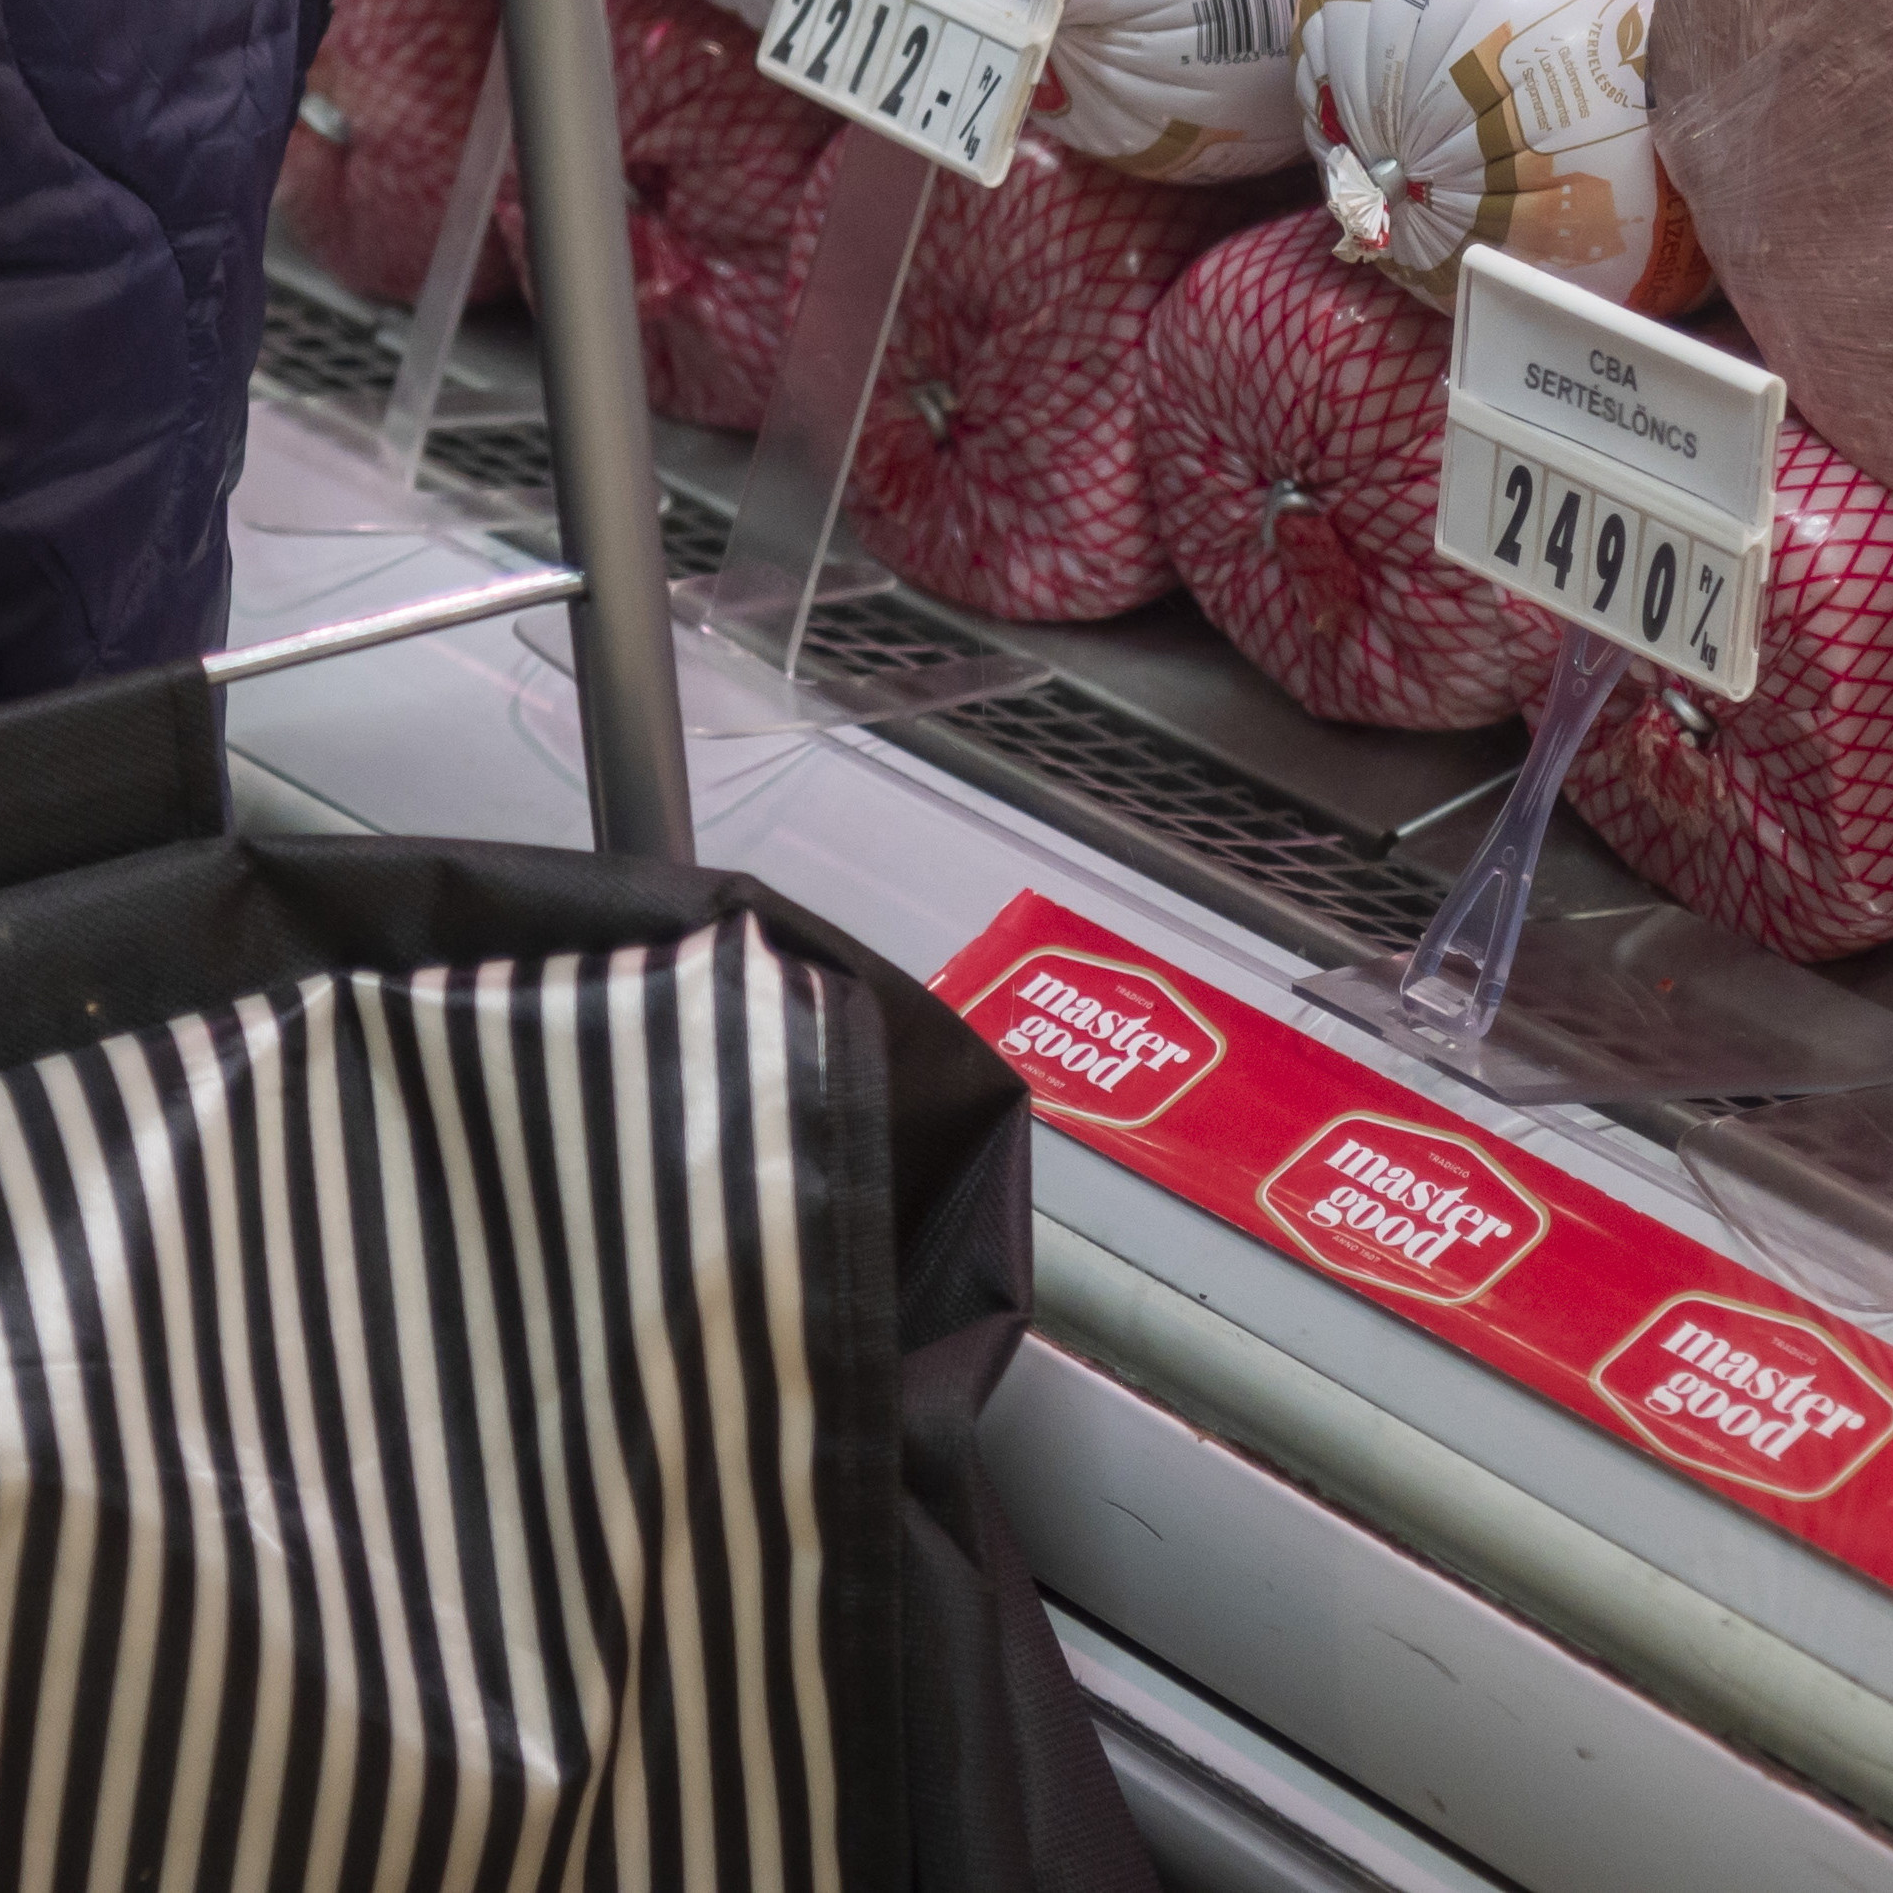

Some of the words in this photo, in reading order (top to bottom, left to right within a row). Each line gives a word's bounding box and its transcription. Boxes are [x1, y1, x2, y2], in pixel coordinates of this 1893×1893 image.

[1586, 20, 1631, 109] TERMELÉSBŐL
[1523, 361, 1700, 461] SERTÉSLÖNCS
[1588, 347, 1640, 394] CBA
[1493, 462, 1679, 645] 2490
[1014, 970, 1191, 1073] master
[1114, 983, 1155, 1011] TRADICIÓ
[997, 1012, 1145, 1094] good
[1020, 1061, 1048, 1081] ANNO
[1323, 1137, 1513, 1248] master
[1427, 1150, 1471, 1180] TRADICIÓ
[1305, 1183, 1465, 1270] good
[1331, 1232, 1360, 1255] ANNO
[1643, 1368, 1812, 1463] good
[1660, 1319, 1867, 1442] master
